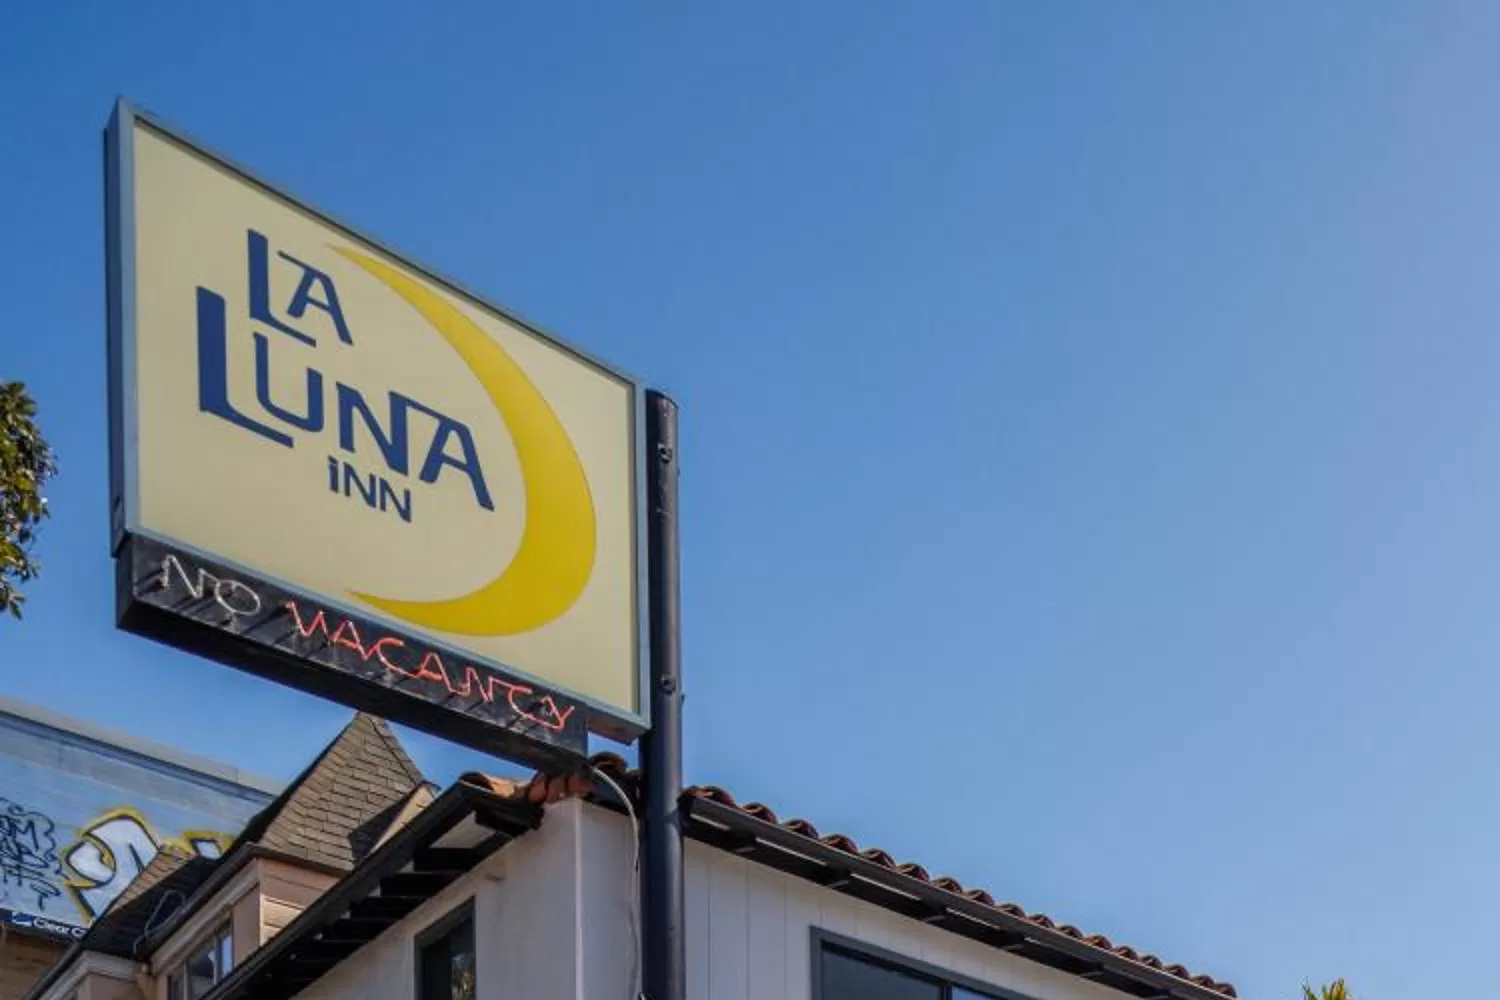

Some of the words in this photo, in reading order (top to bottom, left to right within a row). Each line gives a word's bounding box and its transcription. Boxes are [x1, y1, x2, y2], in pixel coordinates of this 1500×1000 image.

[248, 228, 353, 347] LA
[196, 286, 495, 512] LUNA
[162, 554, 261, 616] NO
[286, 600, 576, 732] VACANCY
